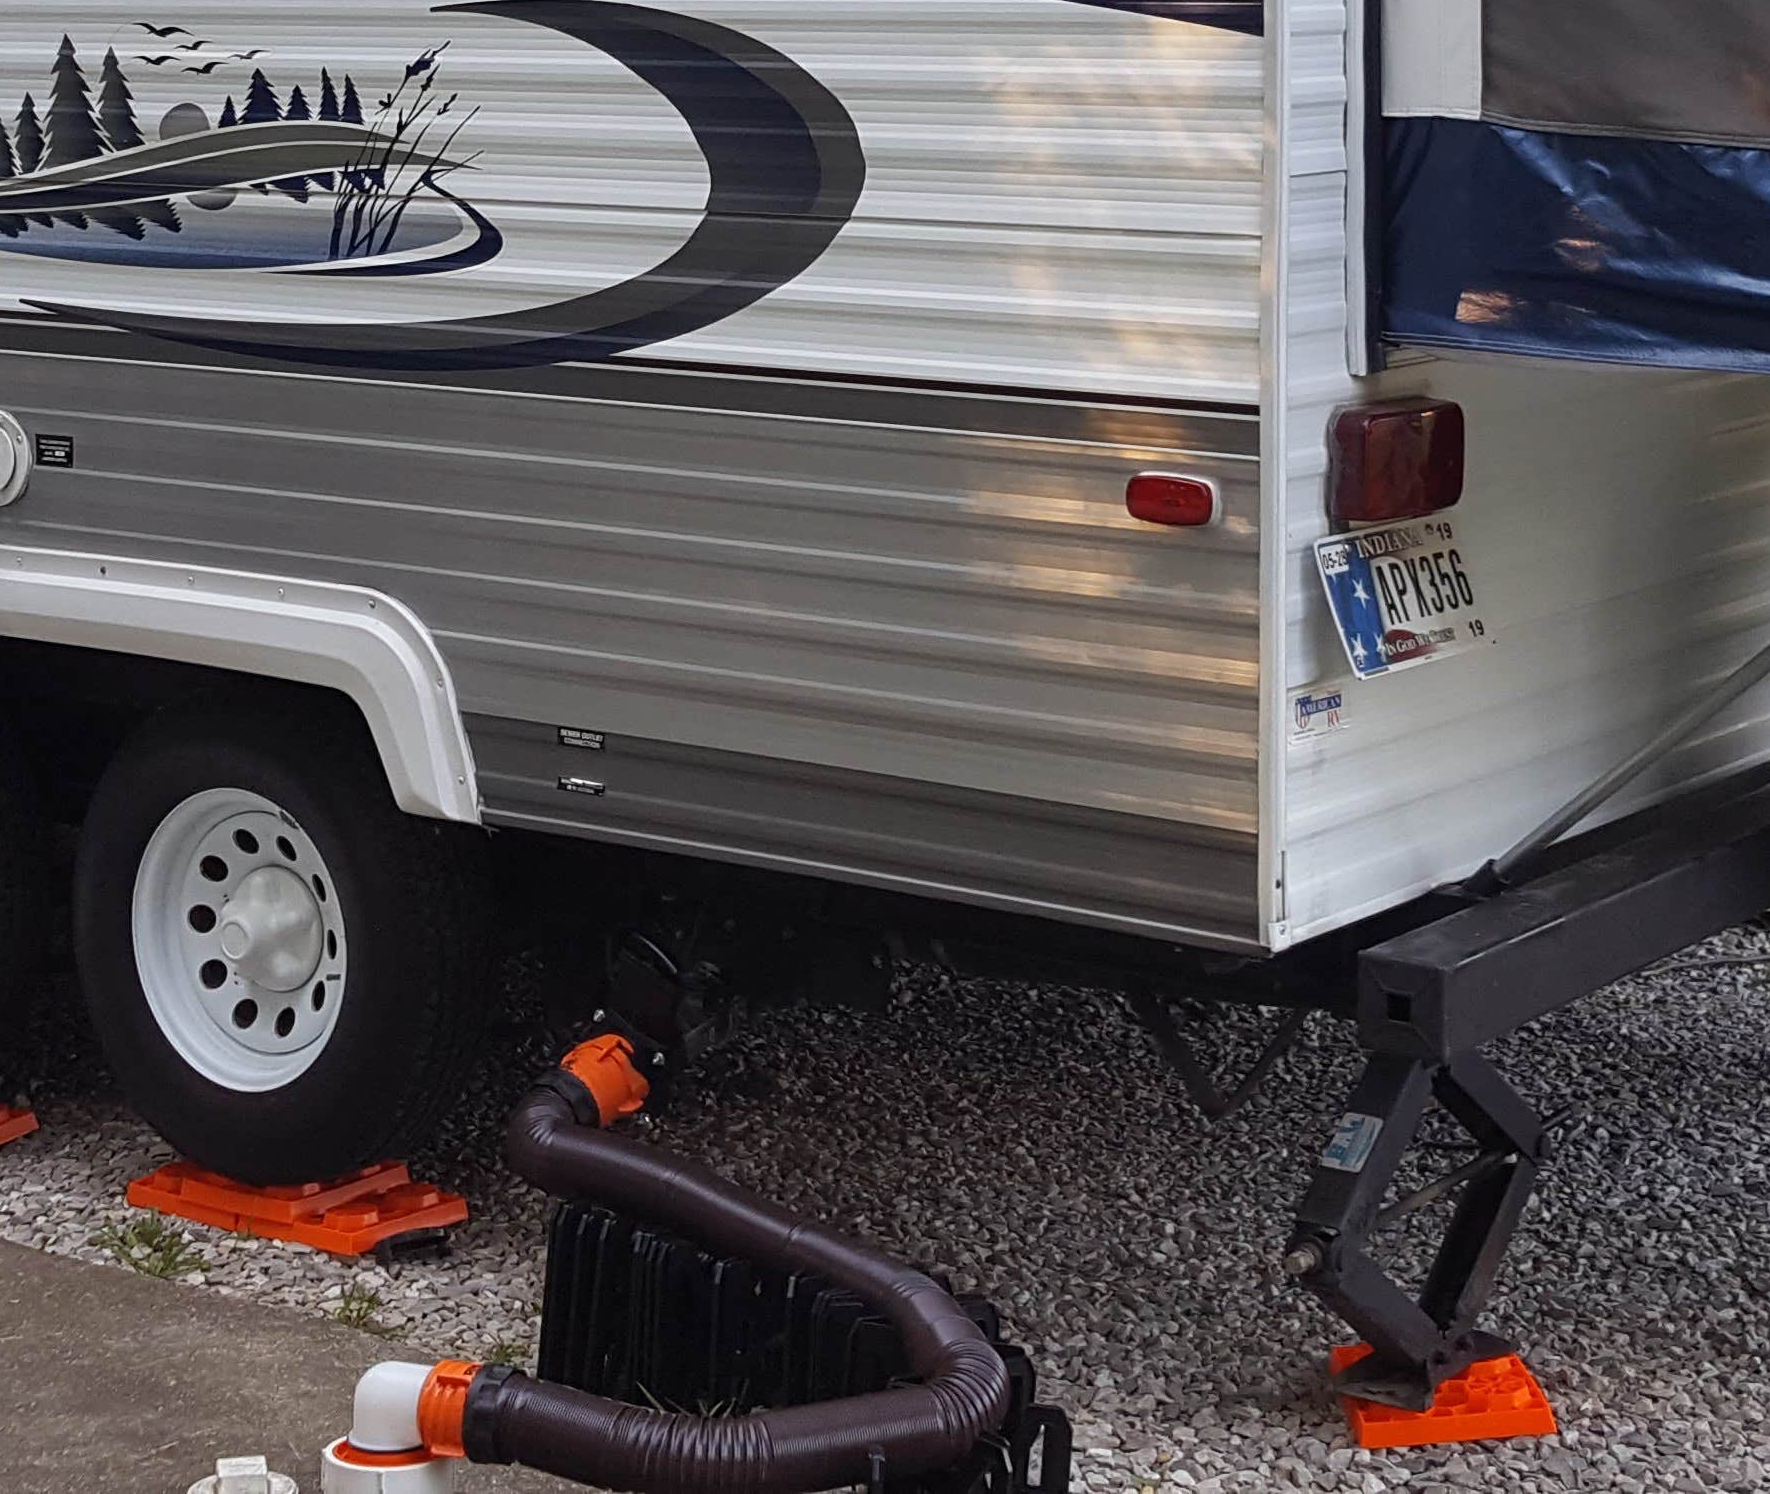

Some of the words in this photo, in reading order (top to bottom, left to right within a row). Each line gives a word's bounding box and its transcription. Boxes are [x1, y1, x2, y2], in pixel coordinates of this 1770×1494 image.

[1355, 527, 1424, 559] INDIANA
[1435, 521, 1453, 541] 19
[1375, 548, 1474, 626] APX356
[1467, 619, 1485, 638] 19
